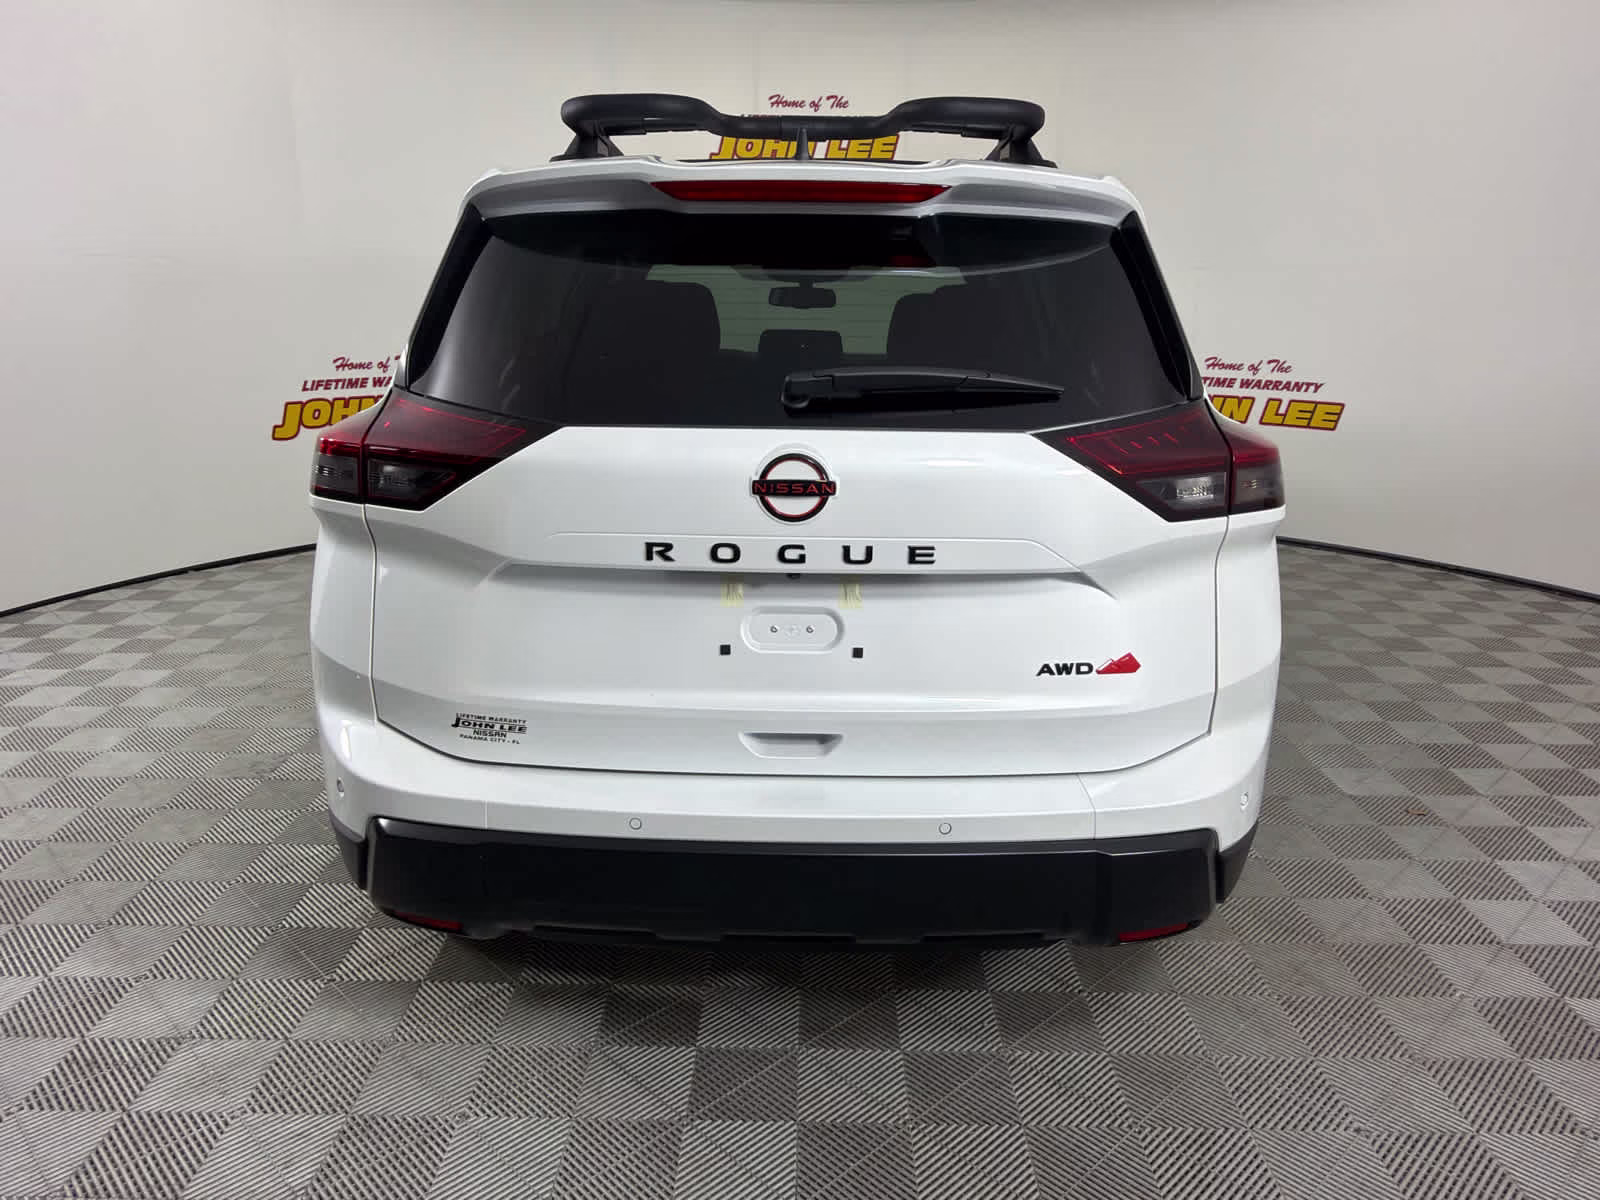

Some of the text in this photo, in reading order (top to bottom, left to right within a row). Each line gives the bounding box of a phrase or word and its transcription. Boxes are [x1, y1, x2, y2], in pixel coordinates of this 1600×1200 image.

[768, 94, 849, 112] Home of The
[825, 132, 900, 160] LEE
[332, 356, 391, 373] Home of
[1204, 356, 1293, 375] Home of The
[301, 377, 369, 392] LIFETIME
[1239, 378, 1325, 394] WARRANTY
[1259, 398, 1346, 431] LEE
[753, 480, 836, 495] NISSAN
[644, 541, 936, 565] ROGUE
[1036, 662, 1094, 676] AWD
[451, 717, 528, 732] JOHN LEE
[473, 729, 507, 738] NISSAN
